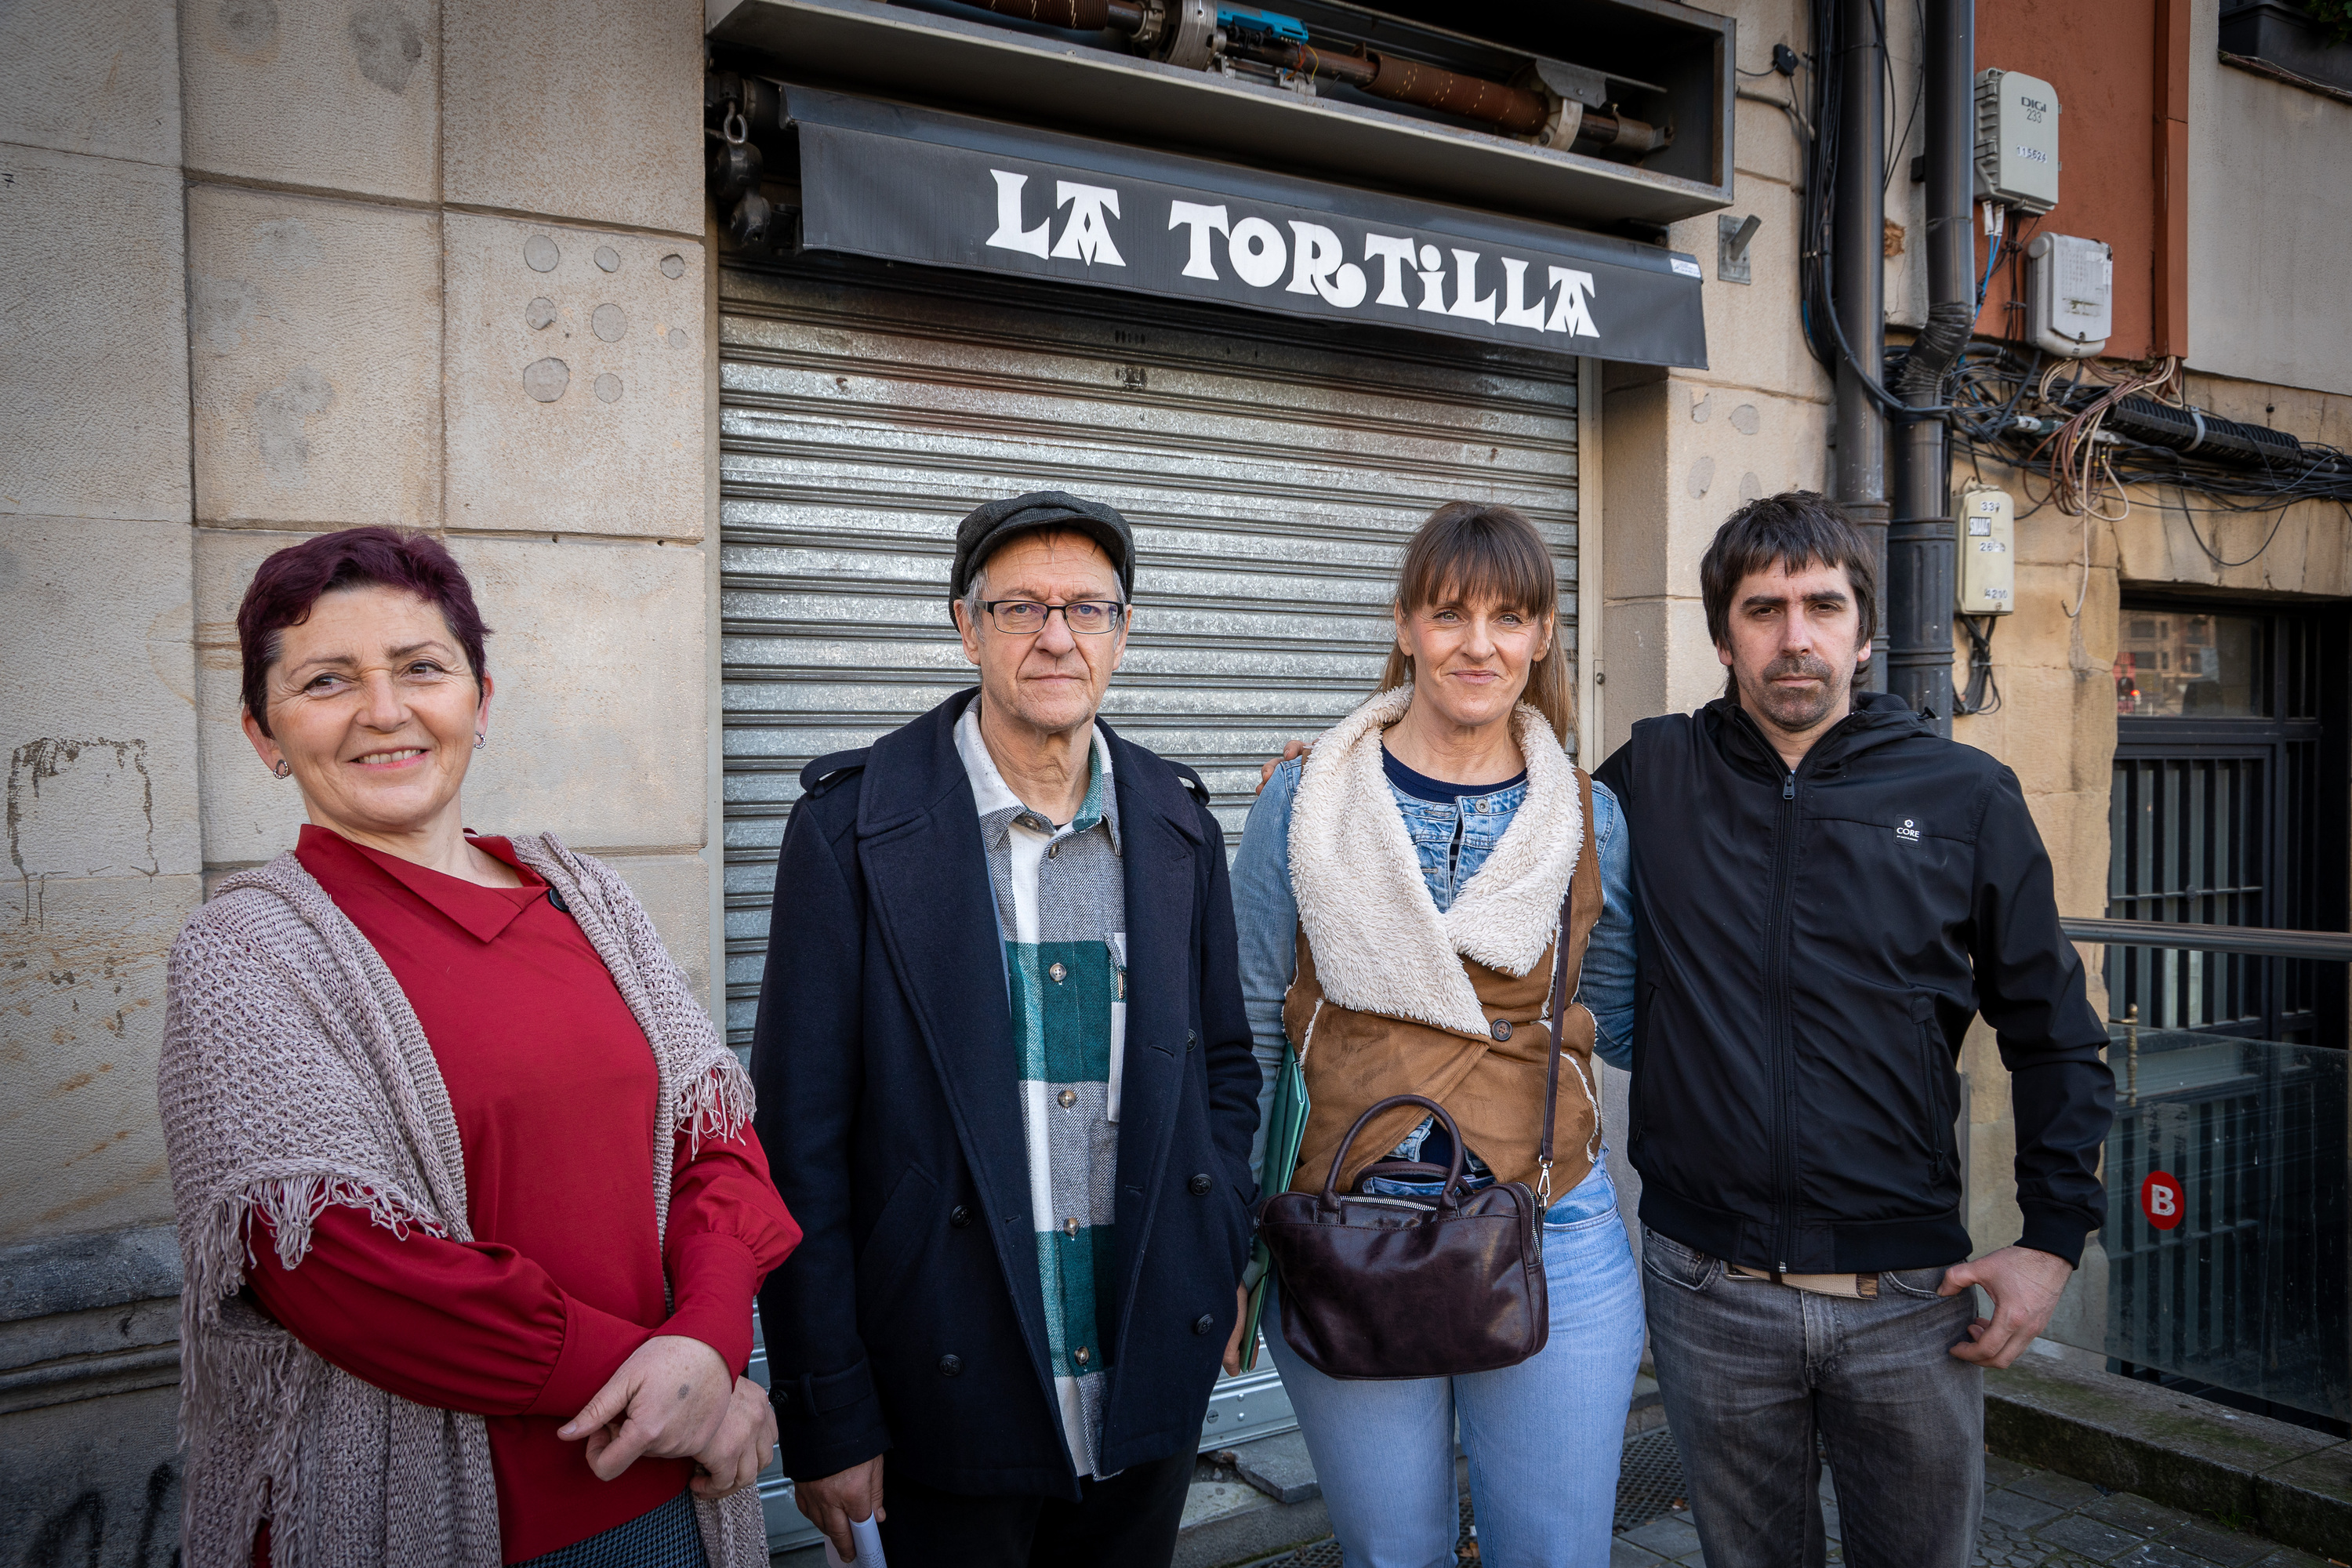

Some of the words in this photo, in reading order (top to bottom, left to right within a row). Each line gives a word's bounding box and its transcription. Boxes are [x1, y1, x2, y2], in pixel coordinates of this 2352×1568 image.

[2021, 96, 2046, 112] DIGI
[2027, 108, 2042, 123] 233
[985, 168, 1126, 267] LA
[1896, 827, 1920, 838] CORE
[2151, 1184, 2176, 1216] B
